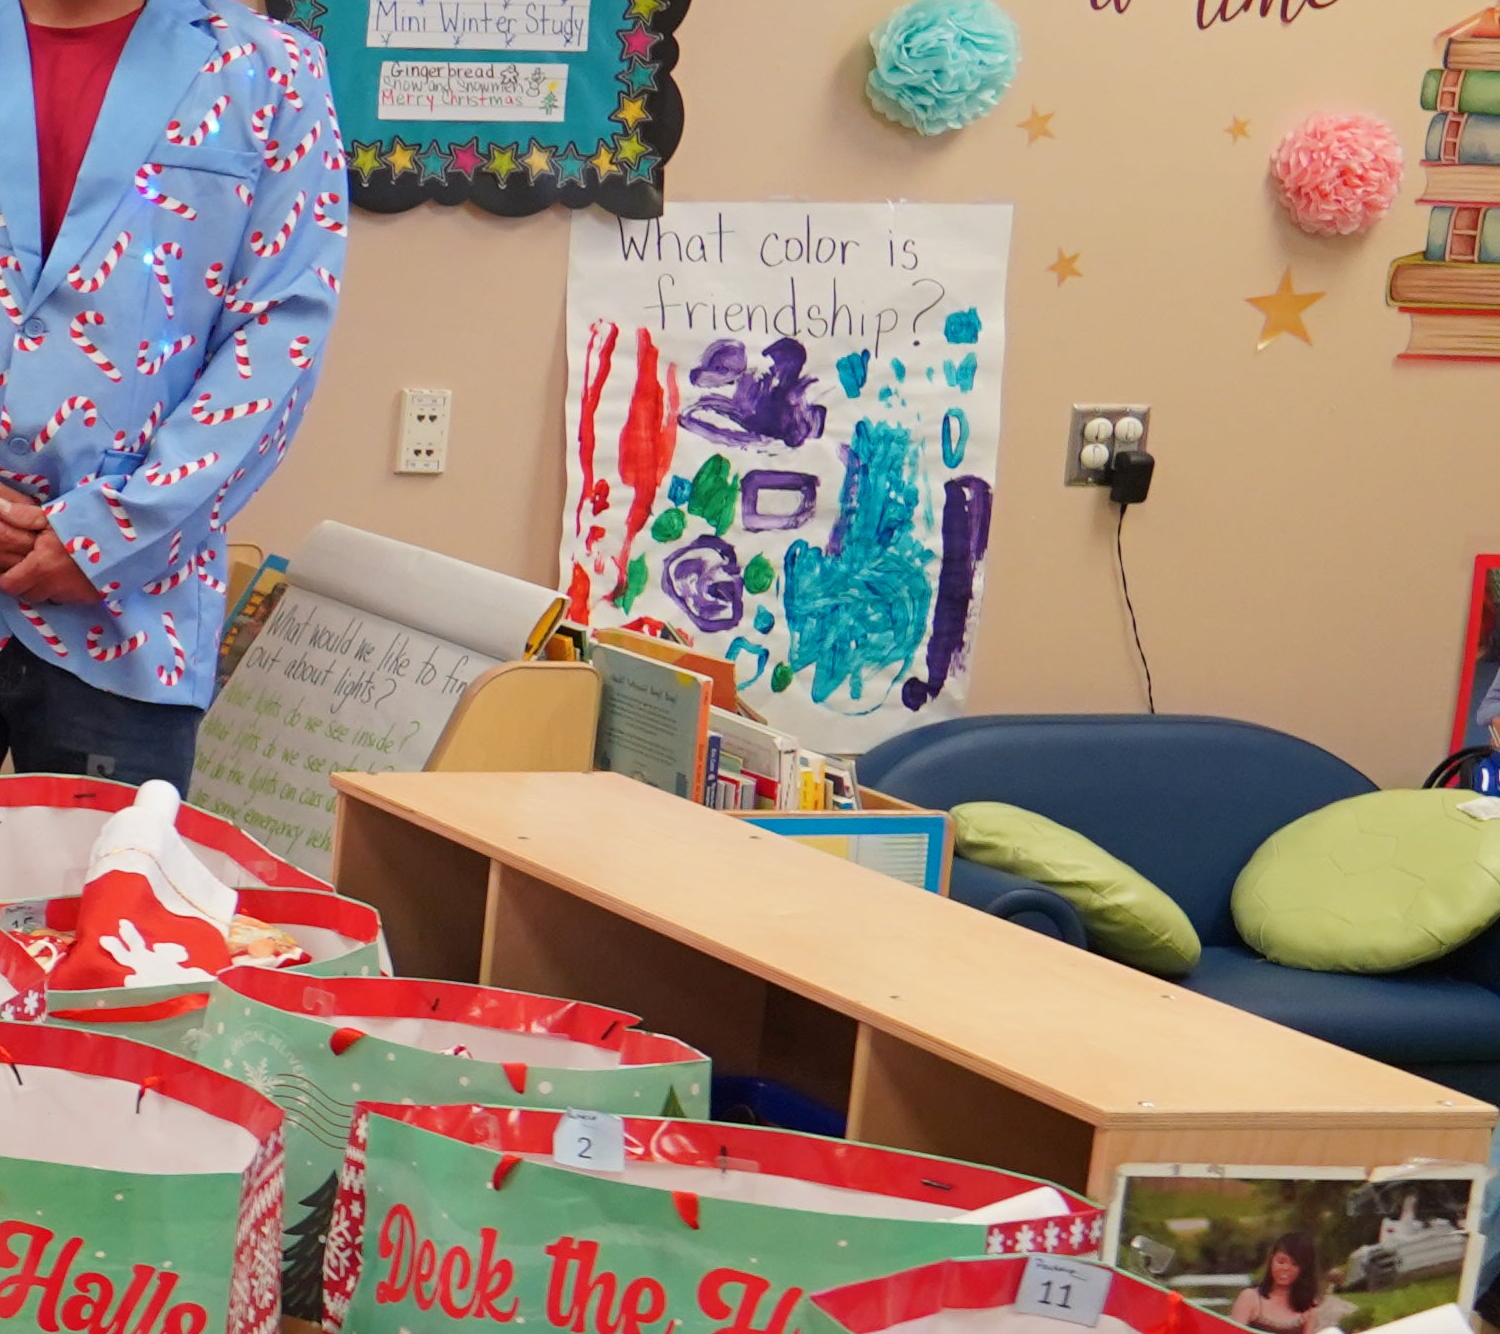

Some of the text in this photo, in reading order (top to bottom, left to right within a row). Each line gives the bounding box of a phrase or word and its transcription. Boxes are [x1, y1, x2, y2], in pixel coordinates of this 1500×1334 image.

[374, 0, 585, 46] Mini Winter Study
[381, 90, 523, 111] Merry Christmas
[429, 78, 454, 92] and
[617, 214, 920, 271] What color is
[646, 274, 946, 358] friendship?
[267, 599, 439, 686] What would like to
[246, 646, 397, 715] out about lights?
[325, 717, 350, 743] see
[578, 1137, 592, 1158] 2
[376, 1202, 519, 1323] Deck
[1038, 1280, 1071, 1309] 11
